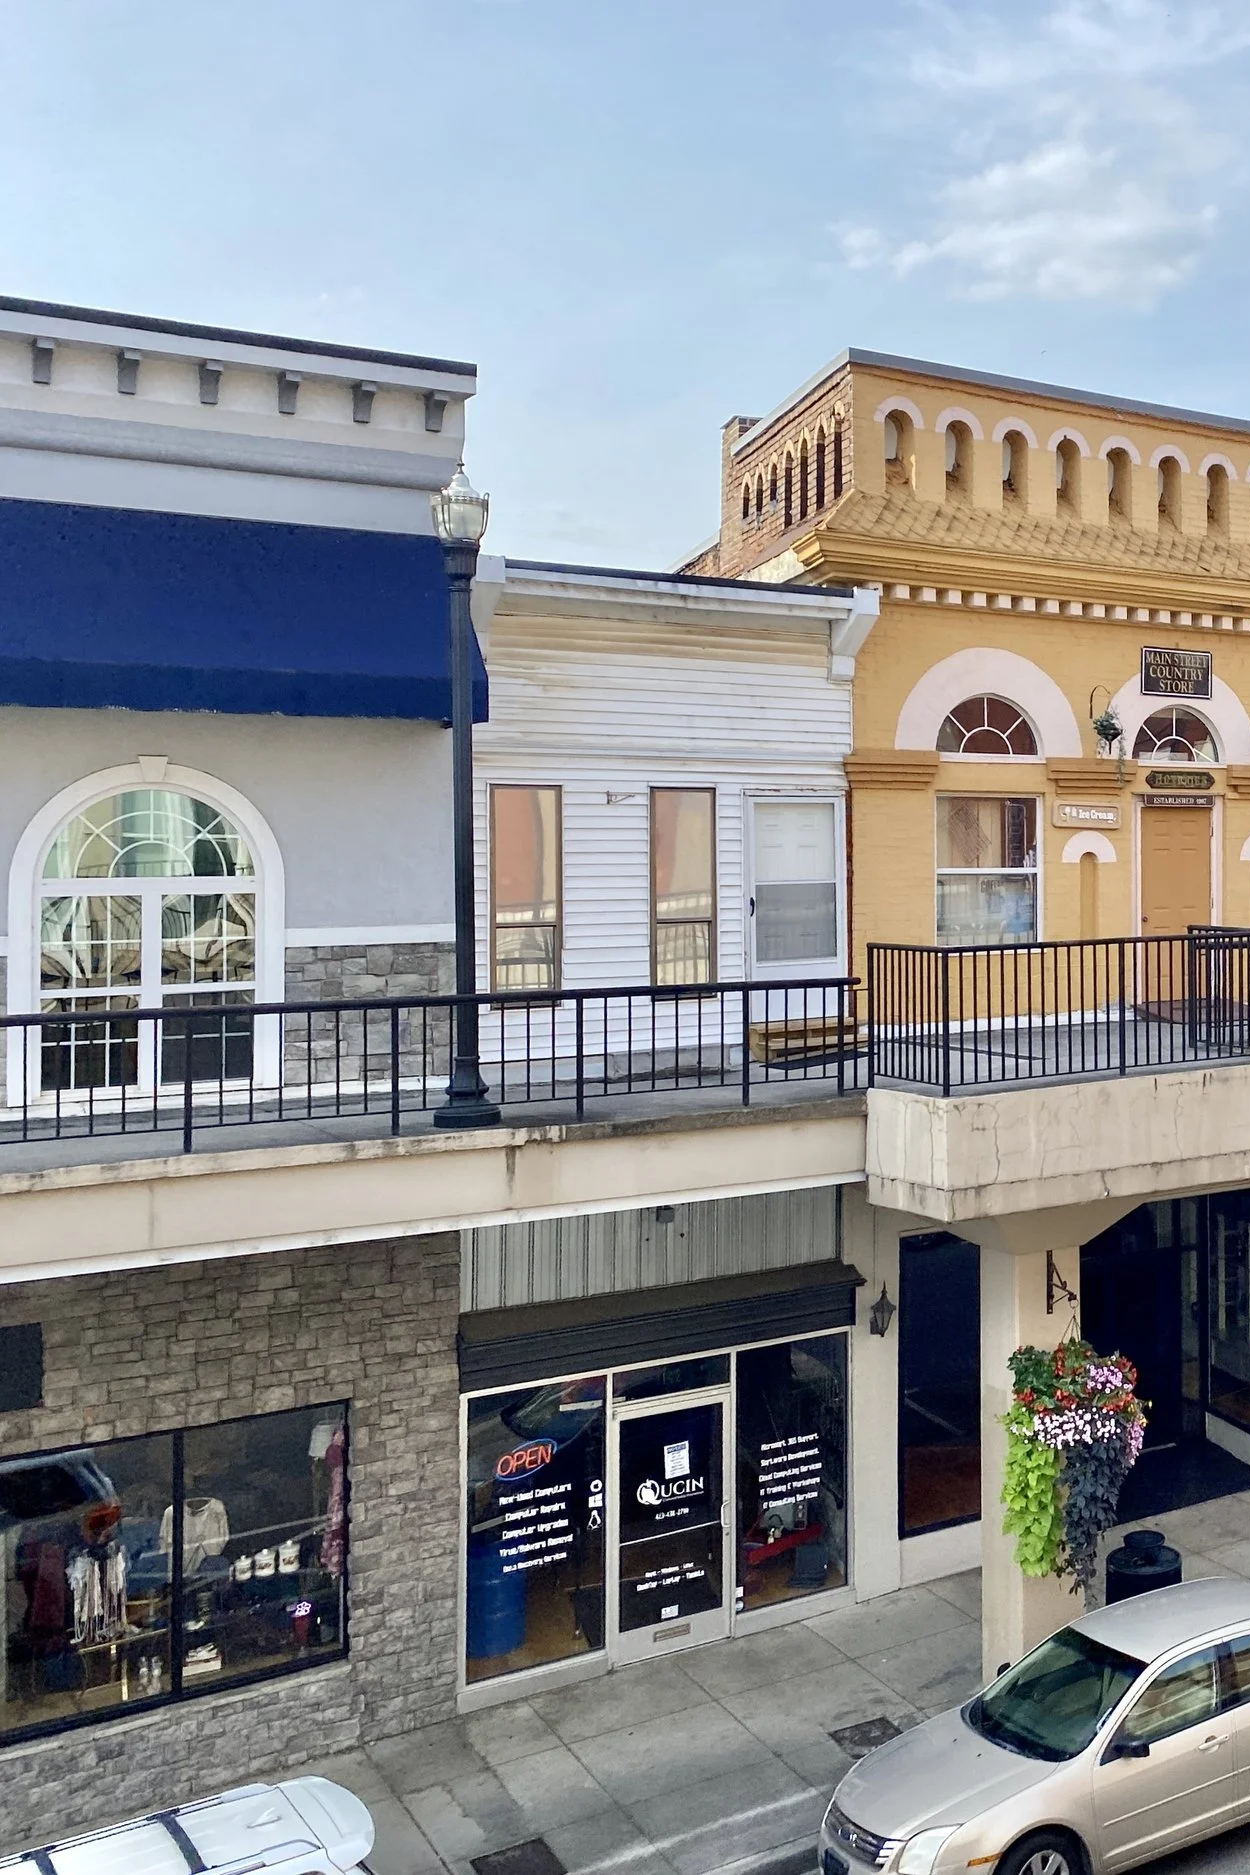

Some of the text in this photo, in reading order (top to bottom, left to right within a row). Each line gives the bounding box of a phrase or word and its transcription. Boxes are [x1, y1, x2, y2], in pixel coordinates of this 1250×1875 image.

[1145, 651, 1209, 668] MAIN STREET
[1149, 665, 1204, 681] COUNTRY
[1159, 679, 1195, 693] STORE
[1153, 796, 1194, 804] ESTABLISHED
[1078, 809, 1090, 819] Ice
[496, 1443, 552, 1476] OPEN
[534, 1483, 572, 1498] Computers
[504, 1508, 539, 1522] Computer
[502, 1525, 537, 1540] Computer
